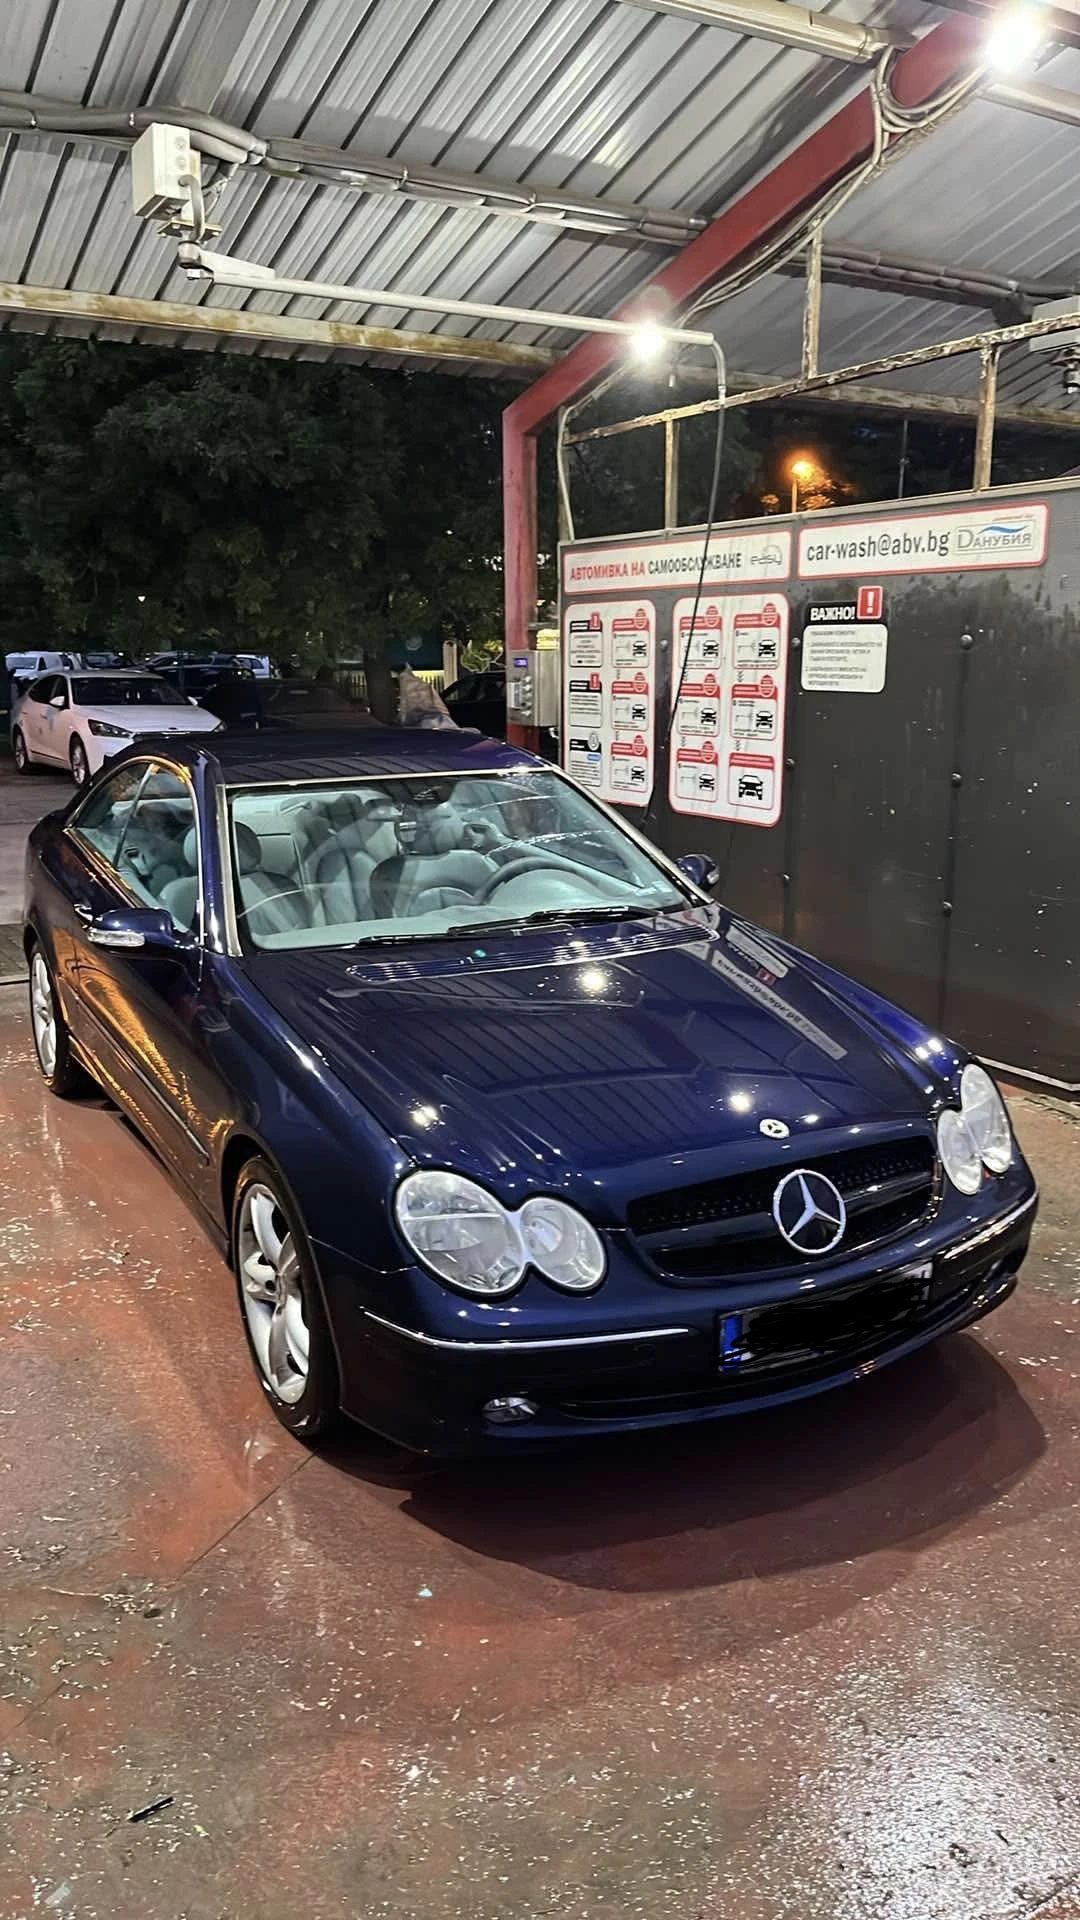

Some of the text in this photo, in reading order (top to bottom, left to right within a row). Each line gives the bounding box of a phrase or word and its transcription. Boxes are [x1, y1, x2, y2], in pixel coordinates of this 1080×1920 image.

[807, 530, 950, 561] car-wash@abv.bg
[570, 563, 628, 581] АВТОМИВКА
[631, 561, 645, 577] НА
[810, 606, 856, 621] ВАЖНО!
